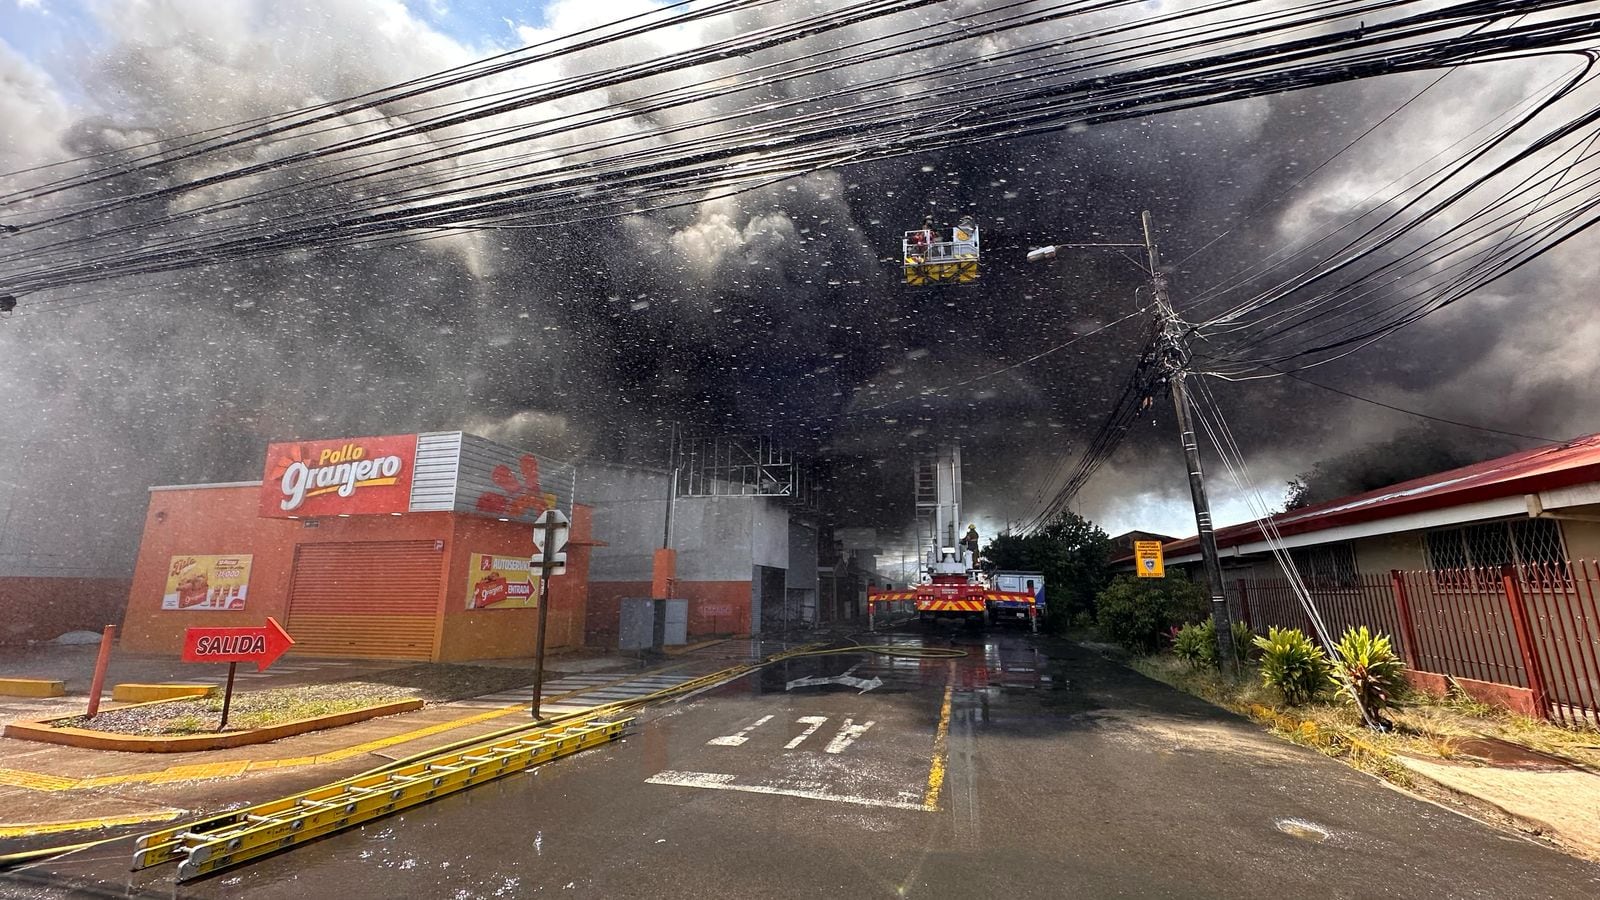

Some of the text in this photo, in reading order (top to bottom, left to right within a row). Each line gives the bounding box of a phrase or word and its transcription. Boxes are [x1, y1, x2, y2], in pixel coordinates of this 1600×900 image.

[319, 443, 364, 465] Pollo
[280, 455, 402, 510] granjero
[508, 585, 530, 595] ENTRADA
[196, 635, 266, 655] SALIDA
